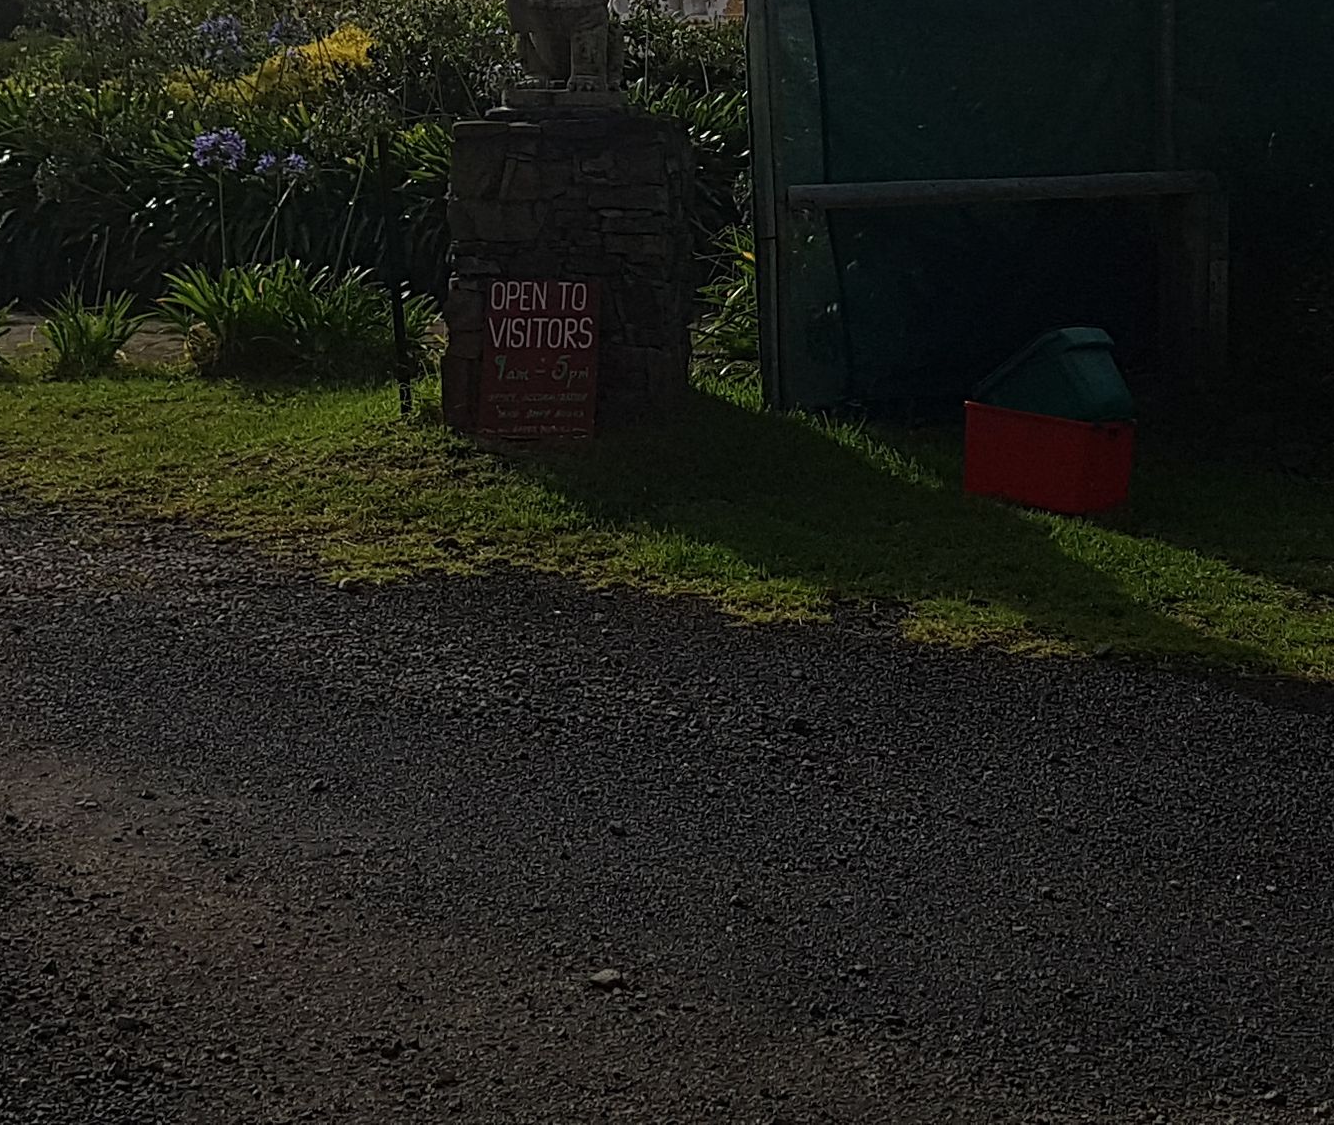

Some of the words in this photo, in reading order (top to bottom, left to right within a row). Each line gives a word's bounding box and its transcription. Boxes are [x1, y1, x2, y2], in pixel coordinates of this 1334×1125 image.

[490, 281, 548, 311] OPEN
[558, 282, 588, 312] TO
[488, 317, 594, 350] VISITORS
